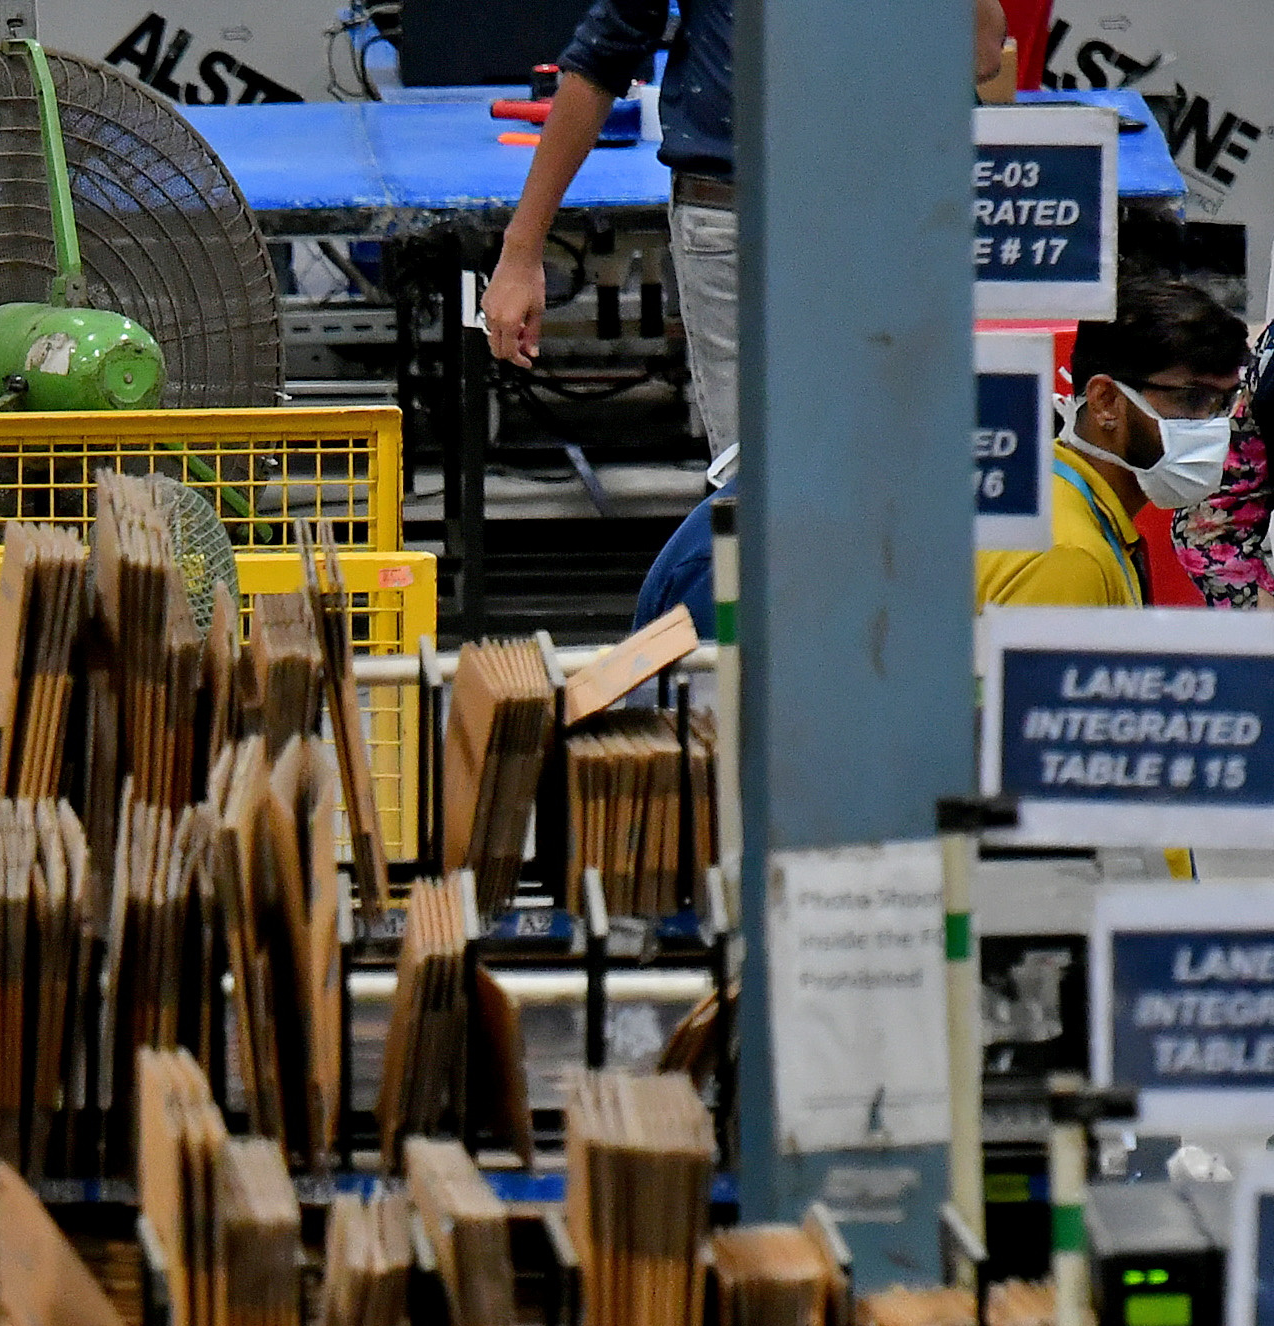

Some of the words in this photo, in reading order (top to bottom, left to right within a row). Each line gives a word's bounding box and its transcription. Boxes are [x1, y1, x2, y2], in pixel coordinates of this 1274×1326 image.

[104, 11, 305, 104] ALST
[972, 161, 1040, 188] E-03
[972, 199, 1080, 226] RATED
[1000, 237, 1022, 265] #
[1031, 238, 1069, 265] 17
[1062, 665, 1217, 701] LANE-03
[1023, 708, 1262, 745] INTEGRATED
[1041, 750, 1164, 787] TABLE
[1204, 754, 1247, 789] 15
